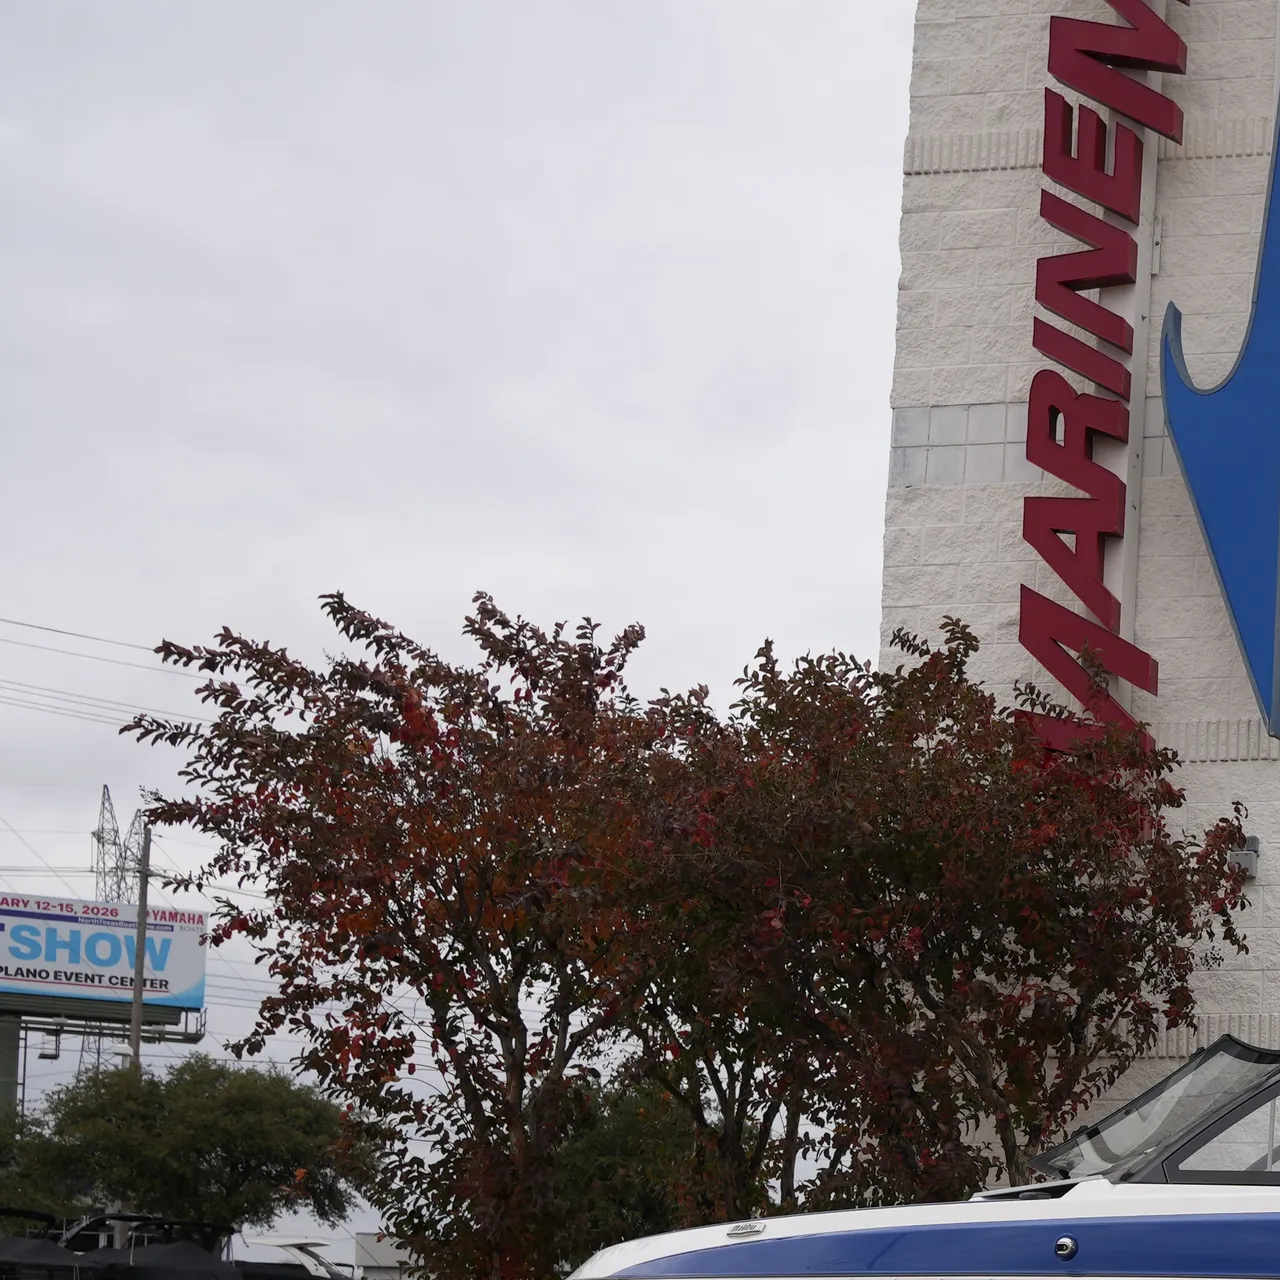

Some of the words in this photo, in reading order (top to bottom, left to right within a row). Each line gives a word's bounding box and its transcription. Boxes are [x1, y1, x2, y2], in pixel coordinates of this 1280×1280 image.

[34, 900, 78, 916] 12-15,
[82, 904, 120, 918] 2026
[152, 909, 205, 926] YAMAHA
[179, 924, 204, 934] BOATS
[7, 923, 173, 973] SHOW
[53, 969, 105, 985] EVENT
